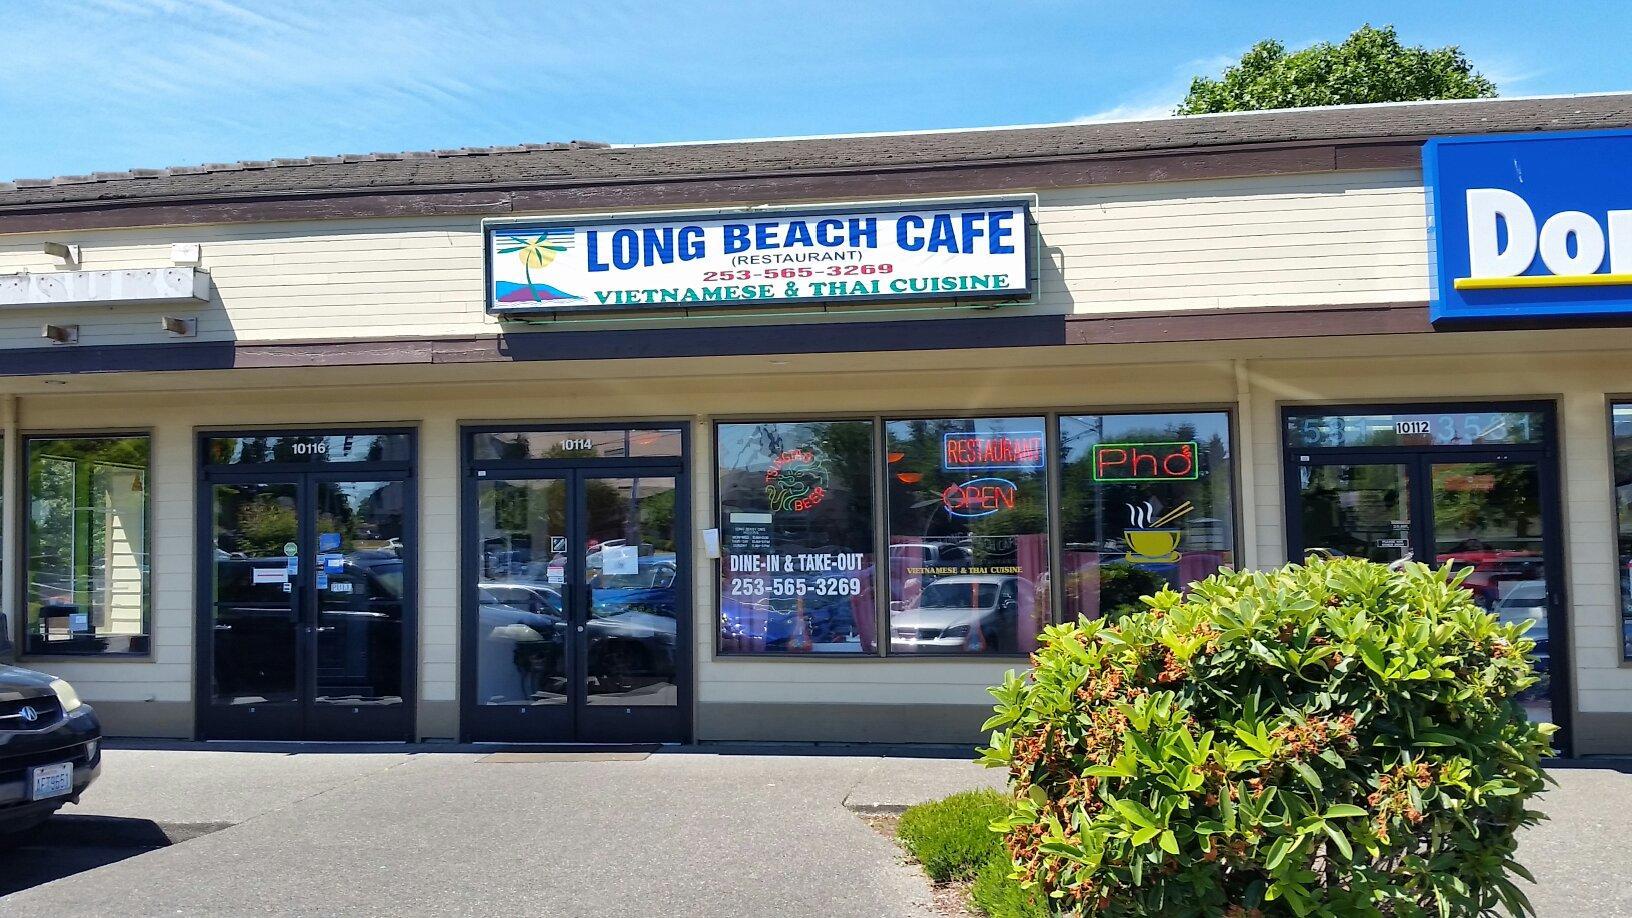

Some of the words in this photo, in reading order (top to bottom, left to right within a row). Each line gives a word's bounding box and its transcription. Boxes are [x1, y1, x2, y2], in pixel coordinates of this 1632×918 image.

[586, 225, 706, 273] LONG
[723, 216, 878, 255] BEACH
[896, 210, 1015, 255] CAFE
[731, 250, 863, 267] (RESTAURANT)
[702, 263, 894, 283] 253-565-3269
[594, 285, 775, 305] VIETNAMESE
[784, 281, 800, 297] &
[809, 279, 881, 297] THAI
[889, 273, 1010, 293] CUISINE
[1397, 422, 1429, 434] 10112
[292, 442, 326, 455] 10116
[561, 438, 592, 451] 10114
[946, 437, 1041, 465] RESTAURANT
[794, 486, 826, 511] BEER
[943, 485, 1016, 510] OPEN
[730, 554, 780, 572] DINE-IN
[784, 554, 794, 572] &
[800, 553, 864, 571] TAKE-OUT
[907, 566, 957, 574] VIETNAMESE
[969, 566, 988, 574] THAI
[990, 565, 1023, 574] CUISINE
[731, 578, 861, 596] 253-565-3269
